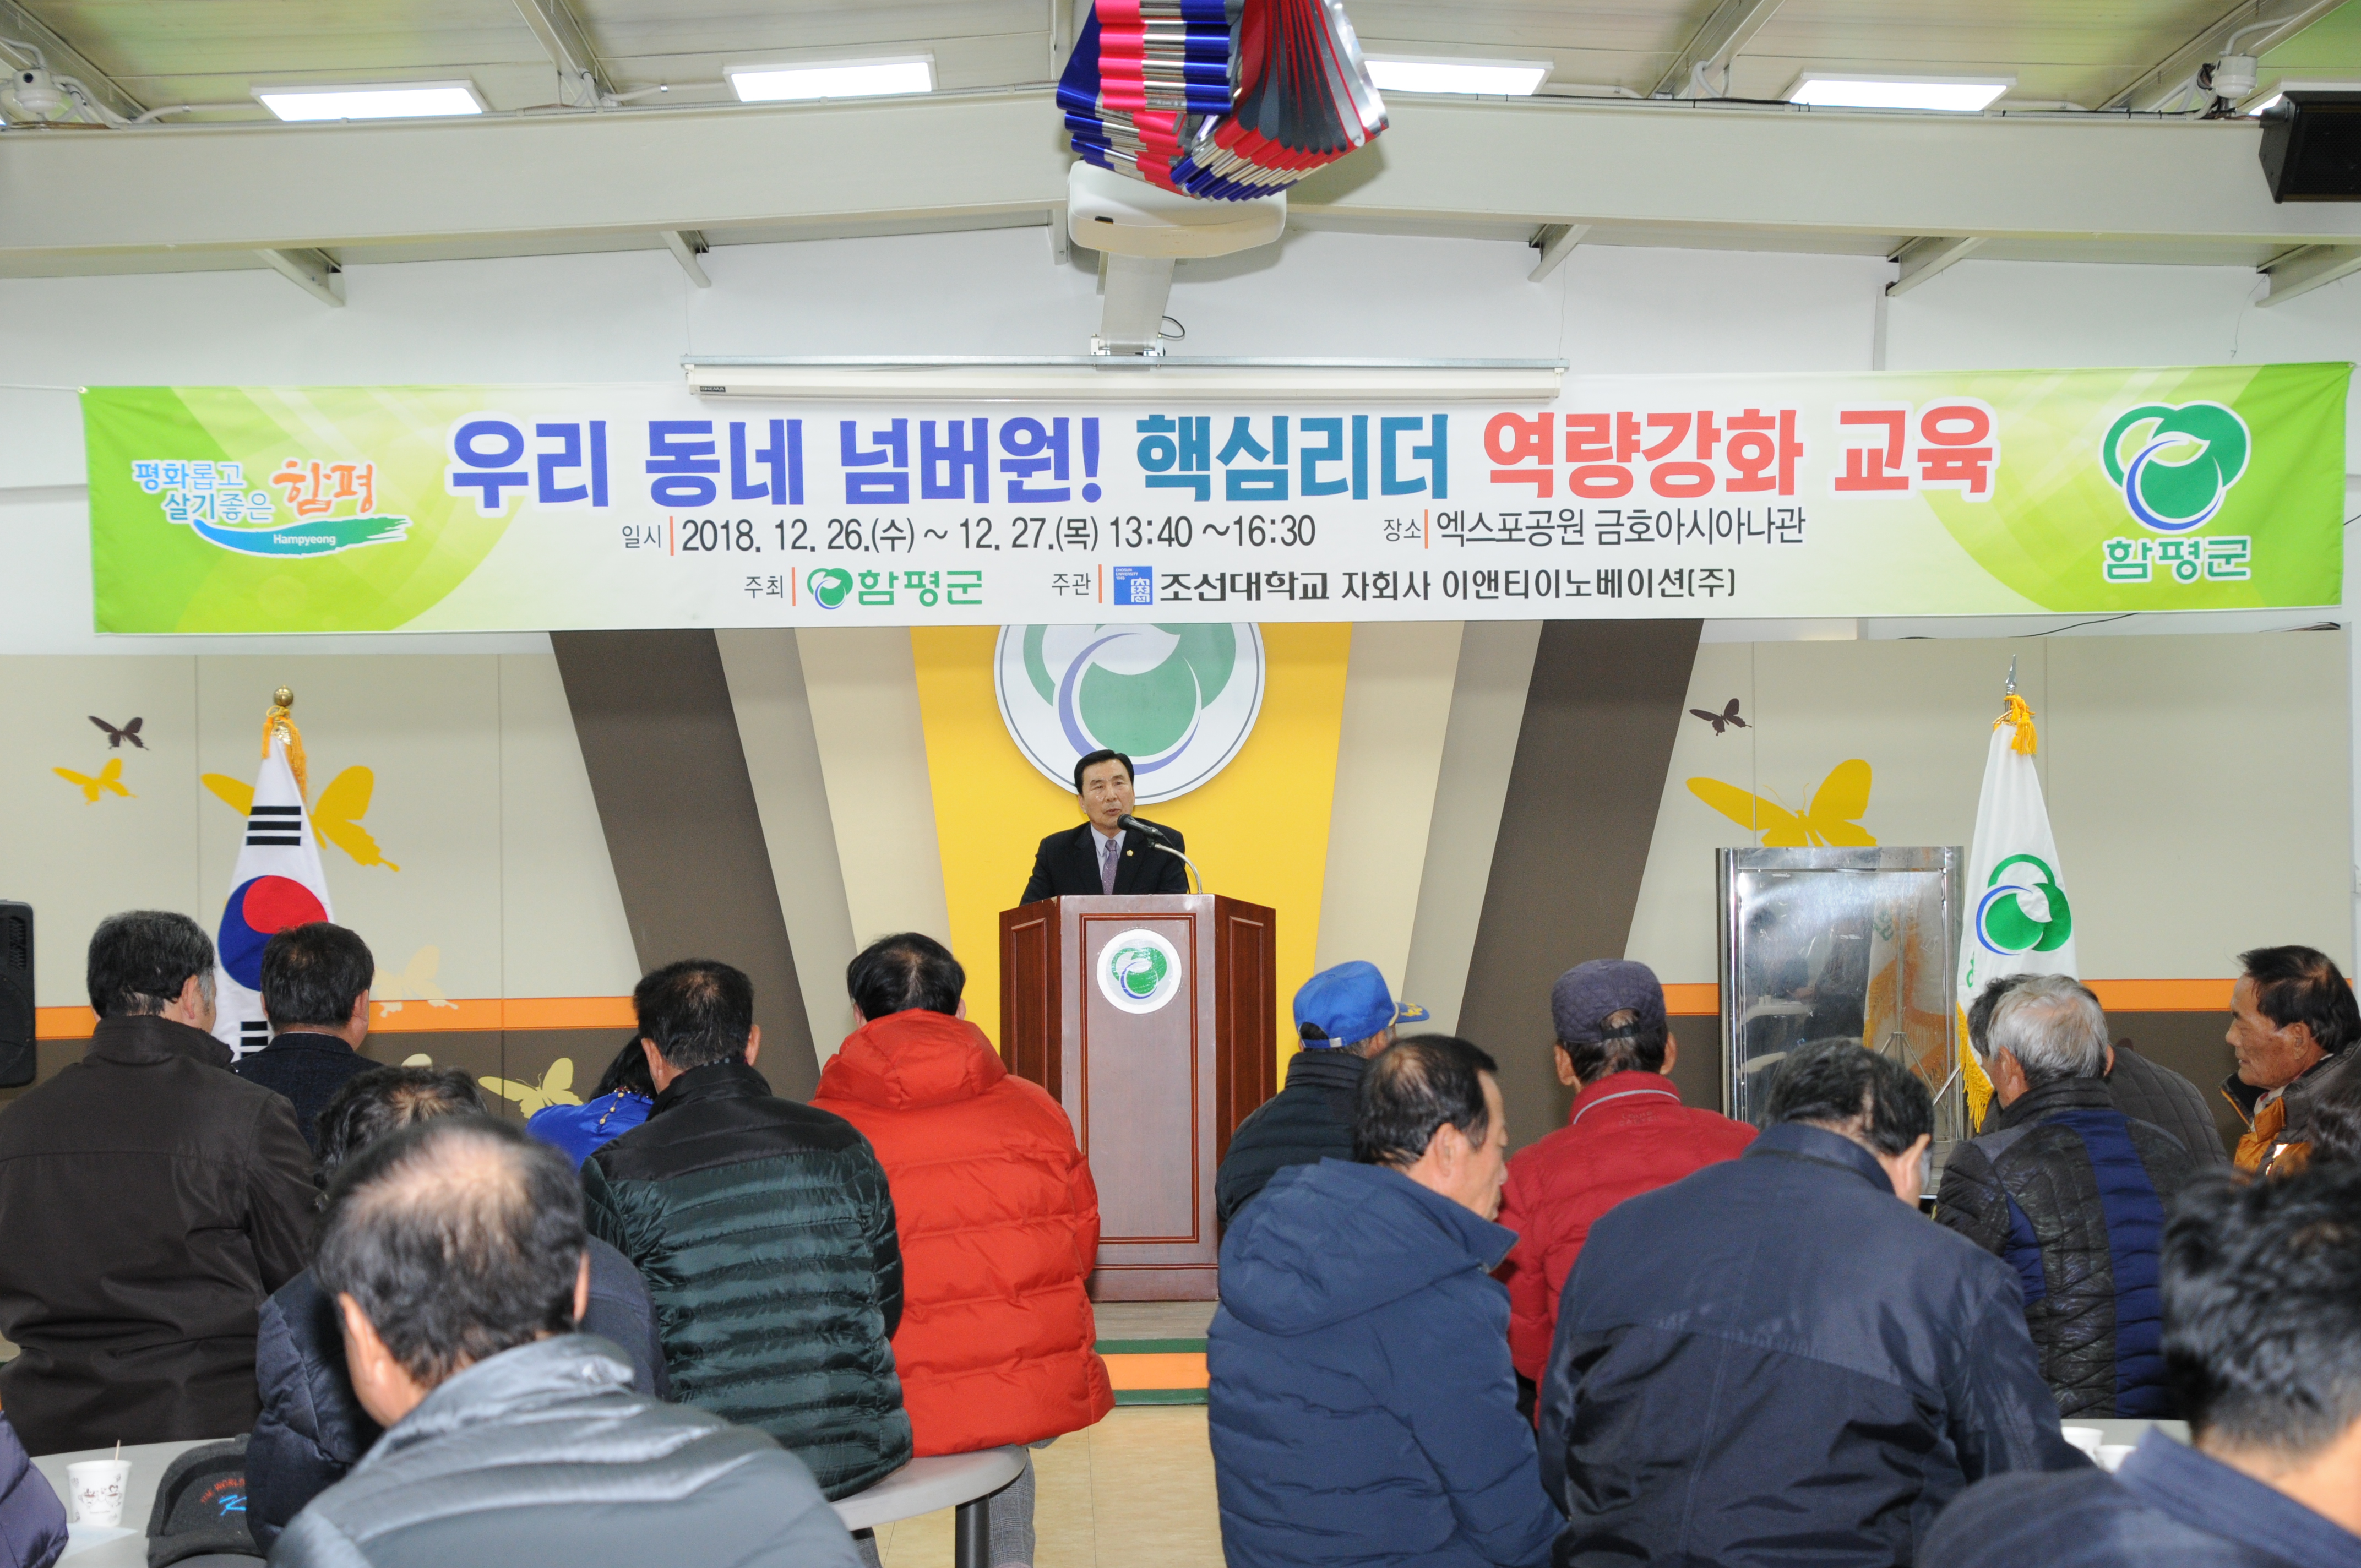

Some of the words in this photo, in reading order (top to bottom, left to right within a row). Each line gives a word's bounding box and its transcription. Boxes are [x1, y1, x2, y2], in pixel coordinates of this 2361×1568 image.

[453, 421, 608, 508] 우리
[646, 419, 804, 507] 동네
[840, 417, 1102, 504] 넘버원!
[1136, 414, 1449, 502] 핵심리더
[1484, 409, 1803, 499] 역량강화
[1835, 406, 1993, 493] 교육
[135, 463, 243, 491] 평화롭고
[272, 460, 375, 516] 함평
[165, 493, 273, 520] 살기좋은
[273, 534, 336, 546] Hampyeong
[622, 525, 661, 548] 일시
[682, 519, 761, 553] 2018.
[775, 519, 815, 552] 12.
[827, 518, 915, 553] 26.(수)
[960, 517, 1000, 551] 12.
[1011, 516, 1098, 552] 27.(목)
[1110, 516, 1193, 548] 13:40
[1384, 518, 1421, 542] 장소
[1437, 508, 1584, 547] 엑스포공원
[1595, 507, 1806, 545] 금호아시아나관
[2106, 538, 2248, 580] 함평군
[744, 575, 783, 598] 주최
[857, 570, 983, 607] 함평군
[1052, 573, 1091, 596] 주관
[1160, 571, 1330, 601] 조선대학교
[1341, 571, 1431, 601] 자회사
[1443, 568, 1735, 600] 이앤티이노베이션(주)
